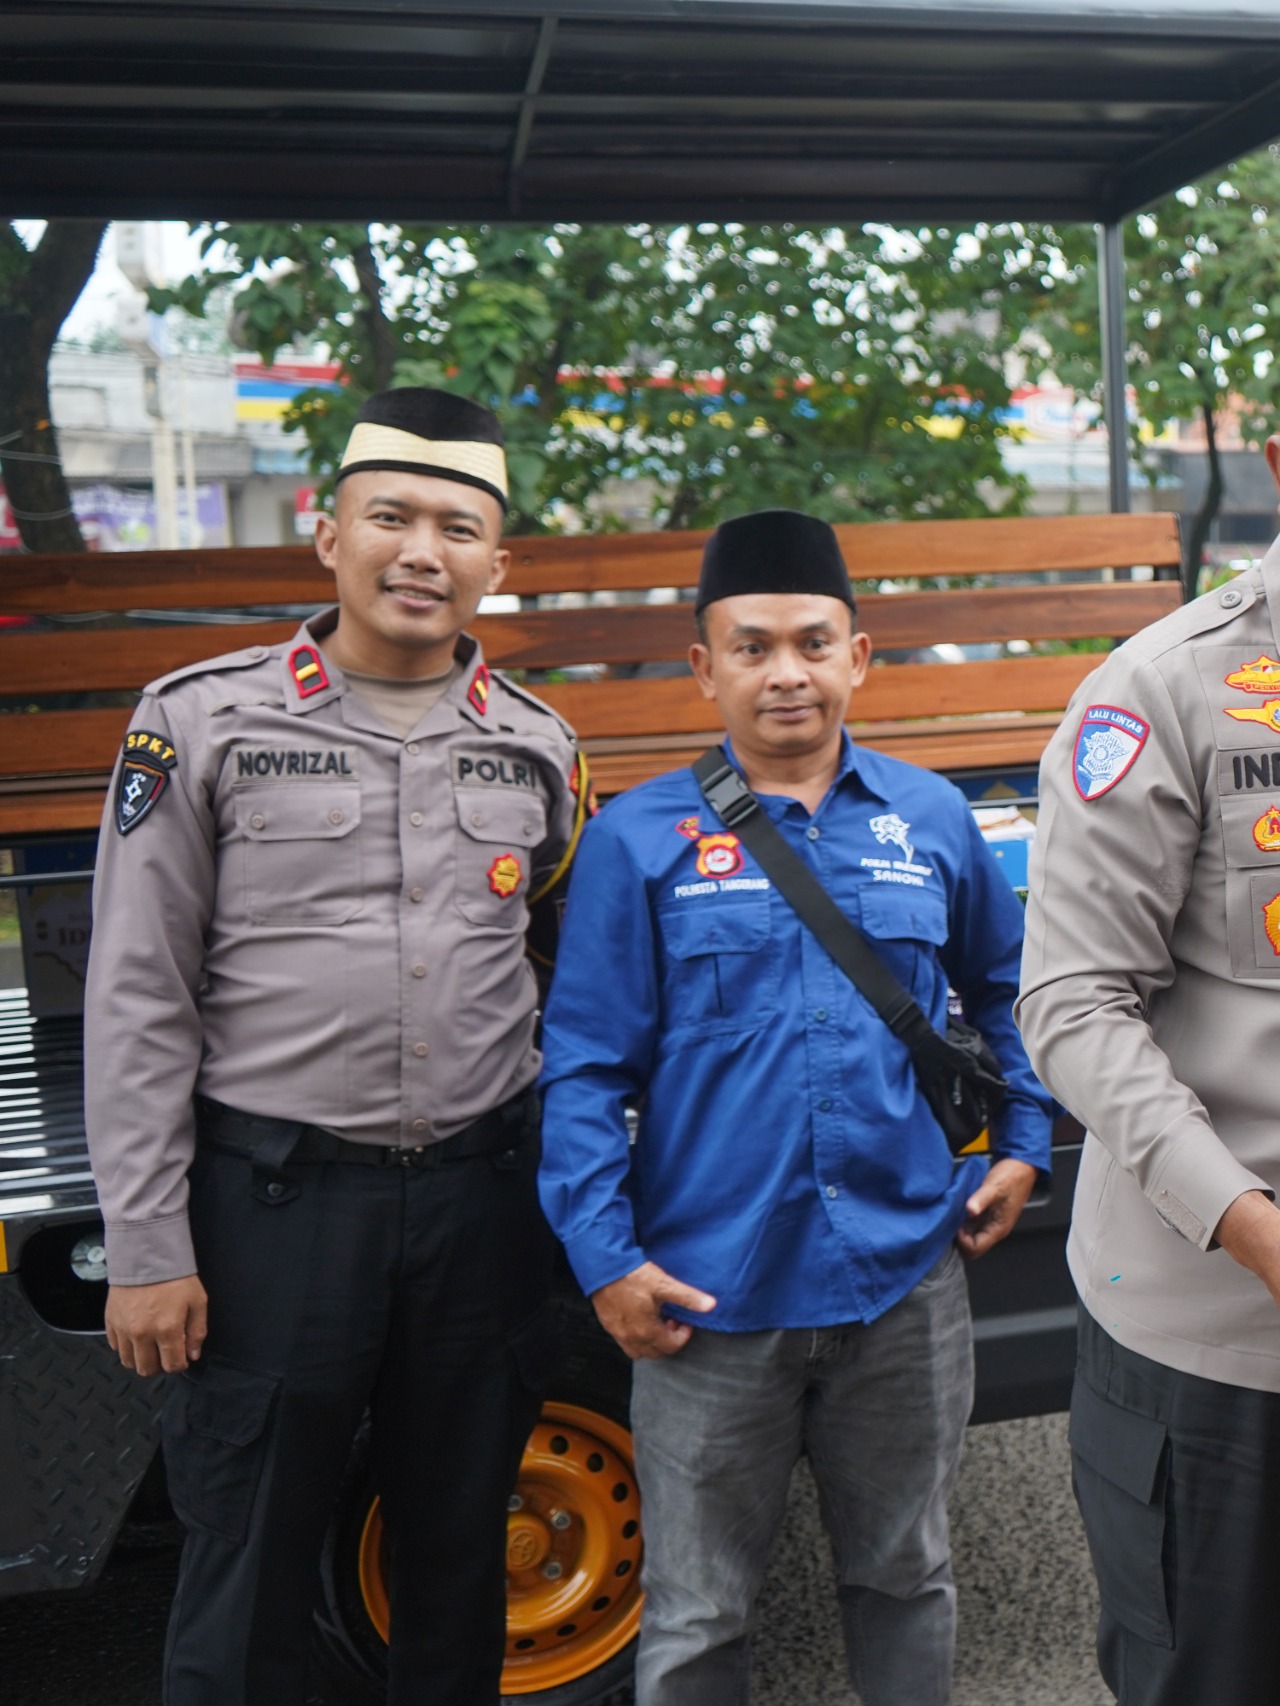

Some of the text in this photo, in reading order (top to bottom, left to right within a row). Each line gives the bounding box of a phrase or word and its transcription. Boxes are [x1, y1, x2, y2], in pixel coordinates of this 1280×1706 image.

[1089, 710, 1143, 733] LALU LINTAS
[127, 734, 174, 760] SPKT
[237, 750, 352, 775] NOVRIZAL
[458, 757, 537, 788] POLRI
